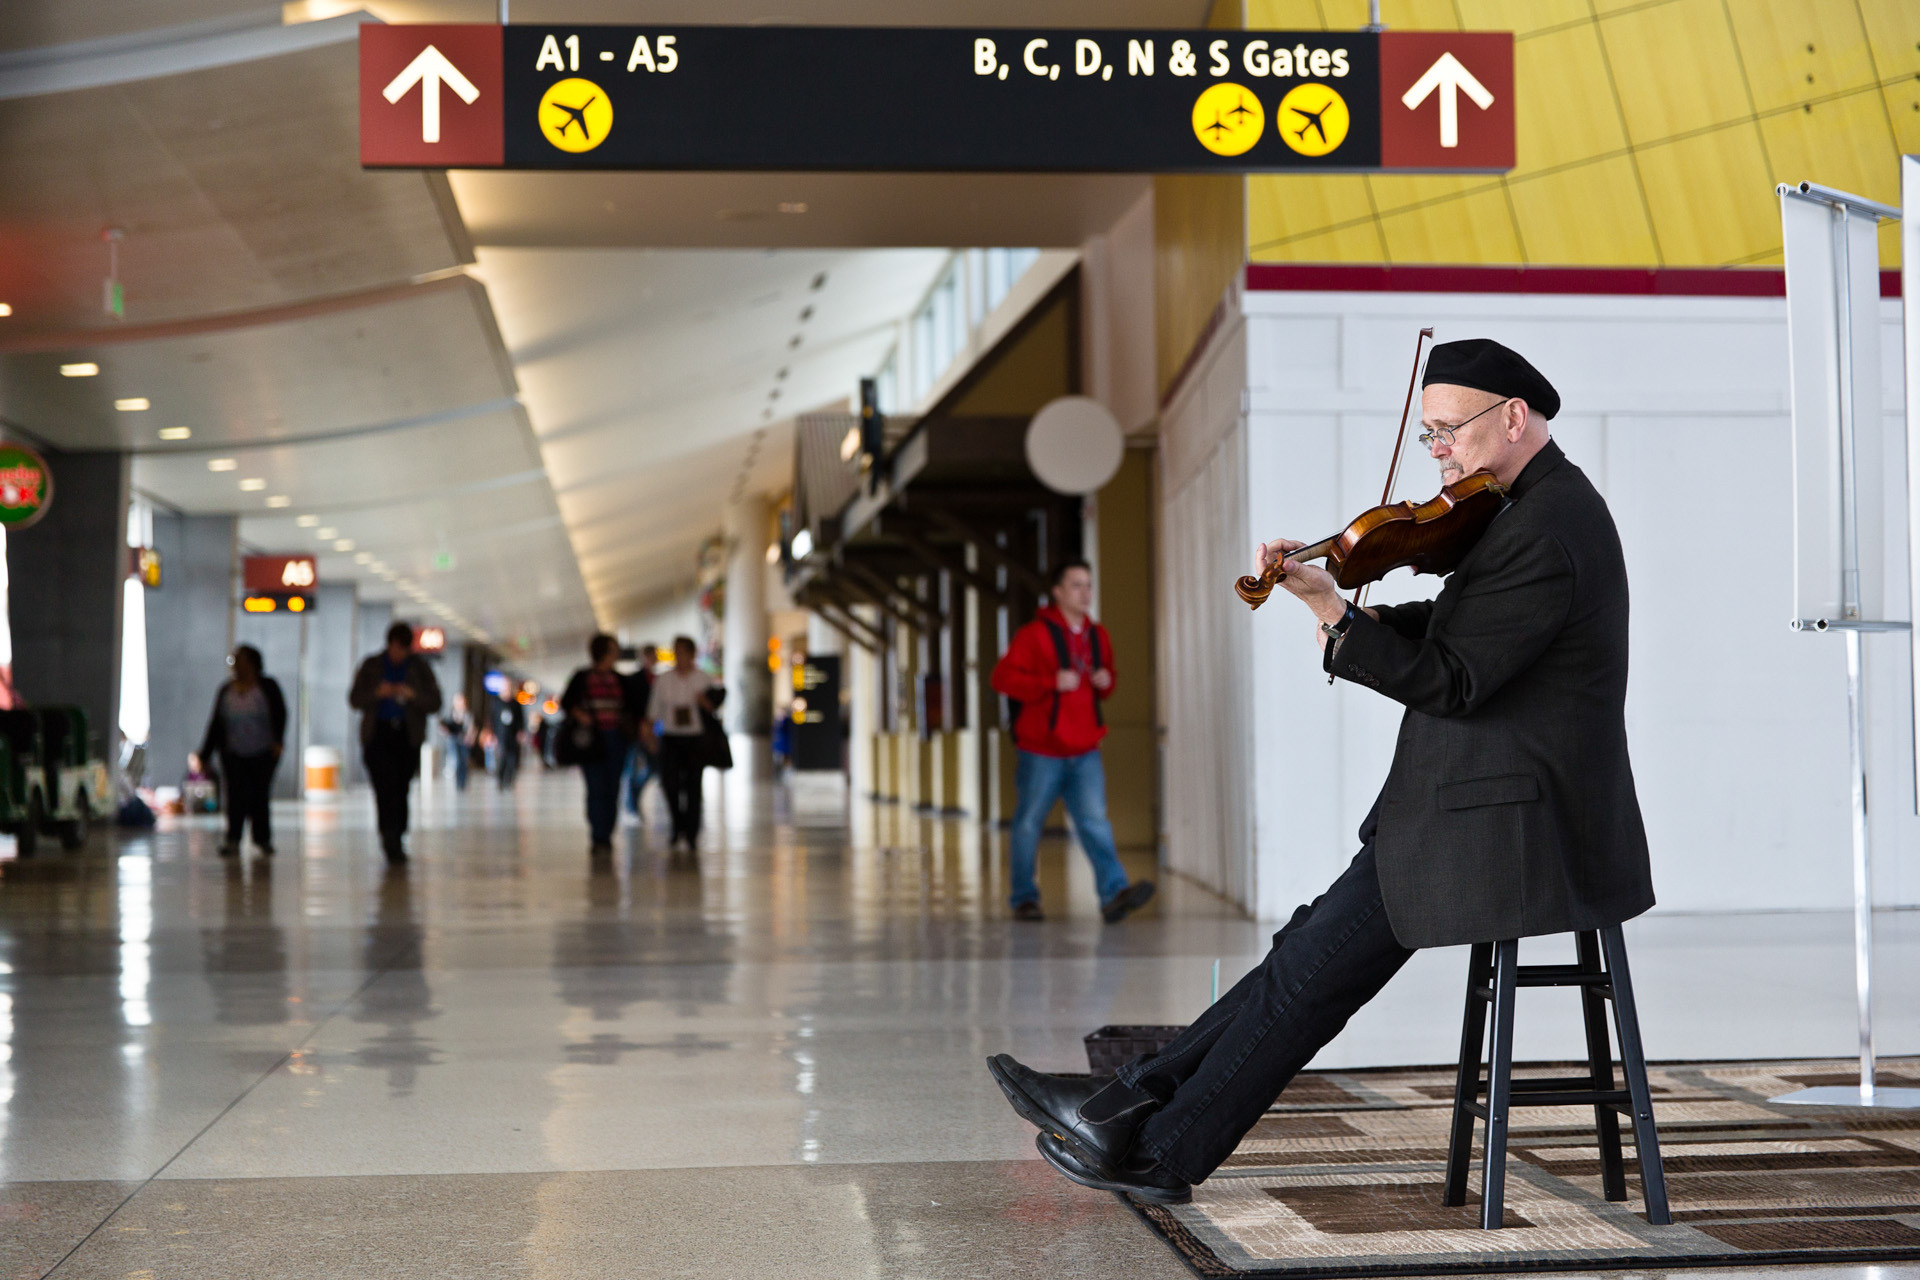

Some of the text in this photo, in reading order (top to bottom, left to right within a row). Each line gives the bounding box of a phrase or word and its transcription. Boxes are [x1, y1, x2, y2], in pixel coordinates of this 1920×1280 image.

[535, 34, 580, 72] A1
[627, 35, 678, 73] A5
[974, 38, 1350, 81] B, C, D, N & S Gates
